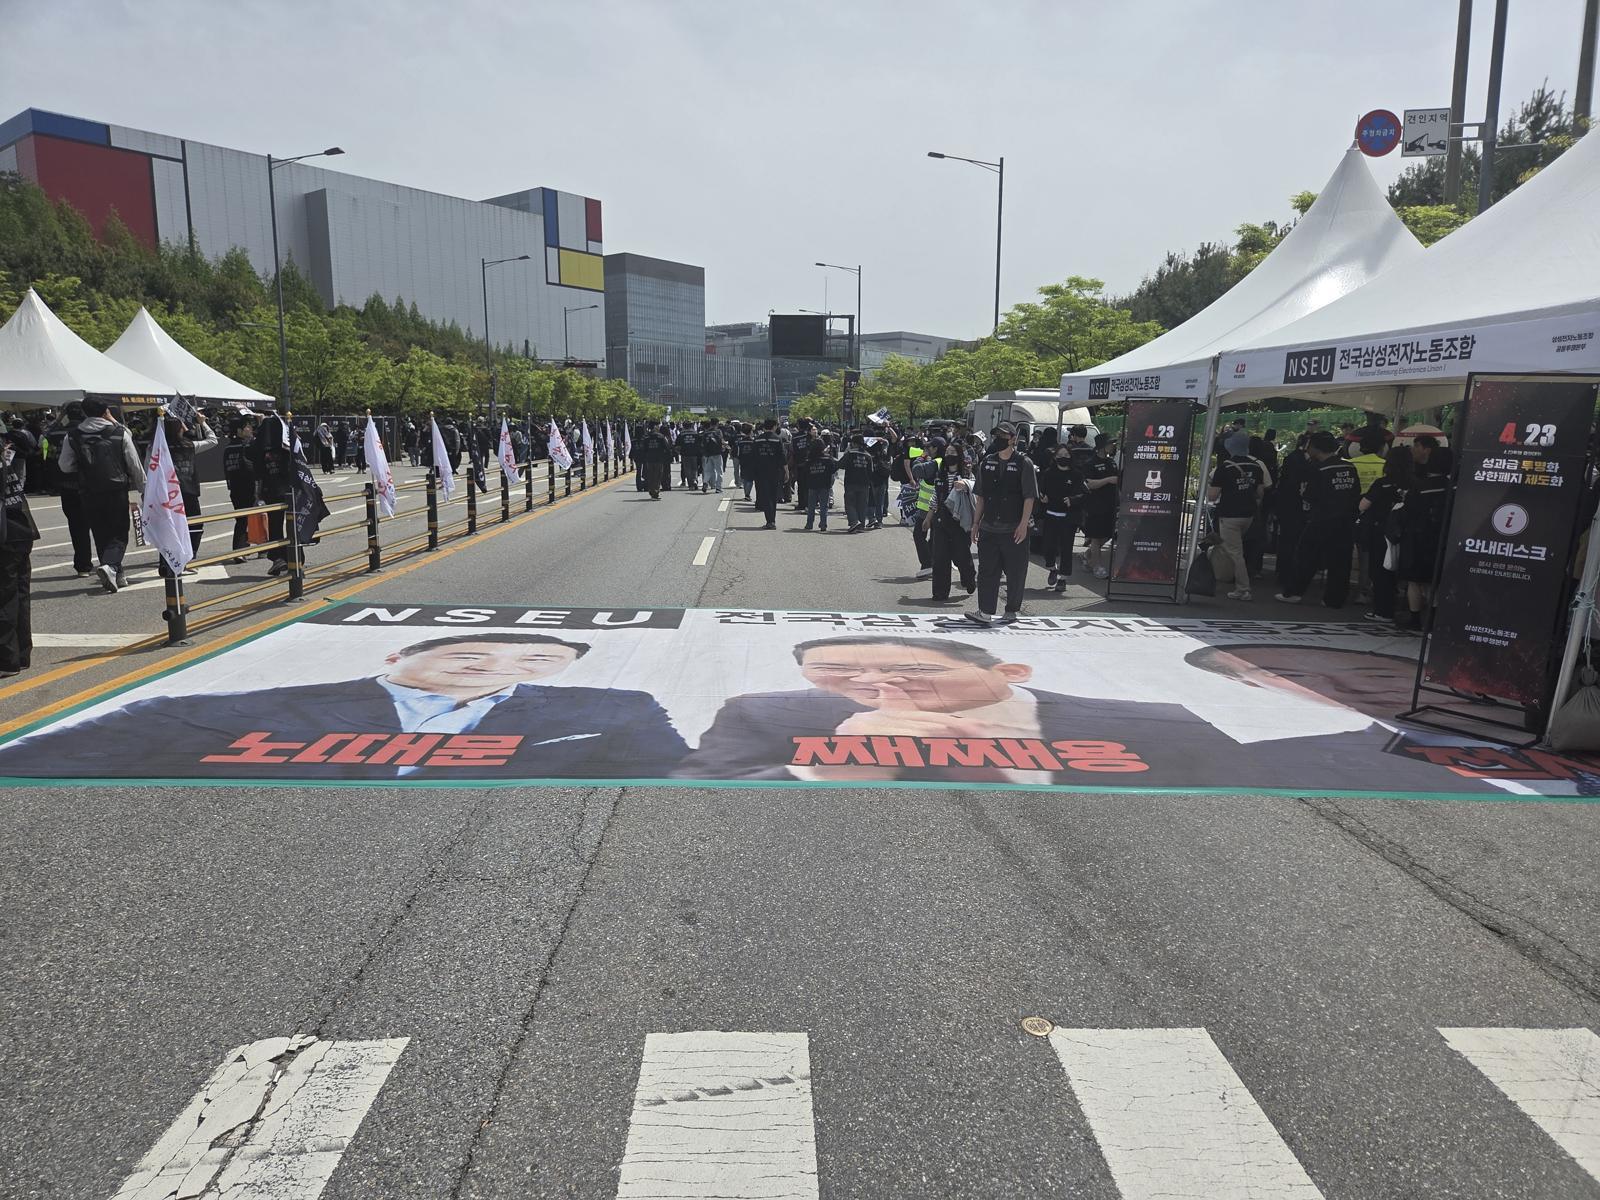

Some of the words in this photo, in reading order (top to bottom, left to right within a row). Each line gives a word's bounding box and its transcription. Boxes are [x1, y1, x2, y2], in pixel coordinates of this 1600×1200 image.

[1408, 113, 1448, 124] 견인지역
[1339, 335, 1476, 370] 전국삼성전자노동조합
[1288, 355, 1332, 377] NSEU
[1090, 381, 1109, 397] NSEU
[1111, 375, 1161, 392] 전국삼성전자노동조합
[1144, 425, 1175, 438] 4.23
[1499, 422, 1557, 447] 4.23
[1482, 458, 1519, 470] 성과급
[1521, 459, 1560, 473] 투명화
[1474, 470, 1522, 484] 상한폐지
[1524, 474, 1564, 488] 제도화
[1133, 492, 1151, 501] 투쟁
[1153, 492, 1171, 501] 조끼
[1465, 538, 1547, 561] 안내데스크
[341, 607, 653, 626] NSEU
[1464, 624, 1518, 639] 삼성전자노동조합
[199, 731, 525, 767] 노때문
[790, 735, 1150, 773] 째째용
